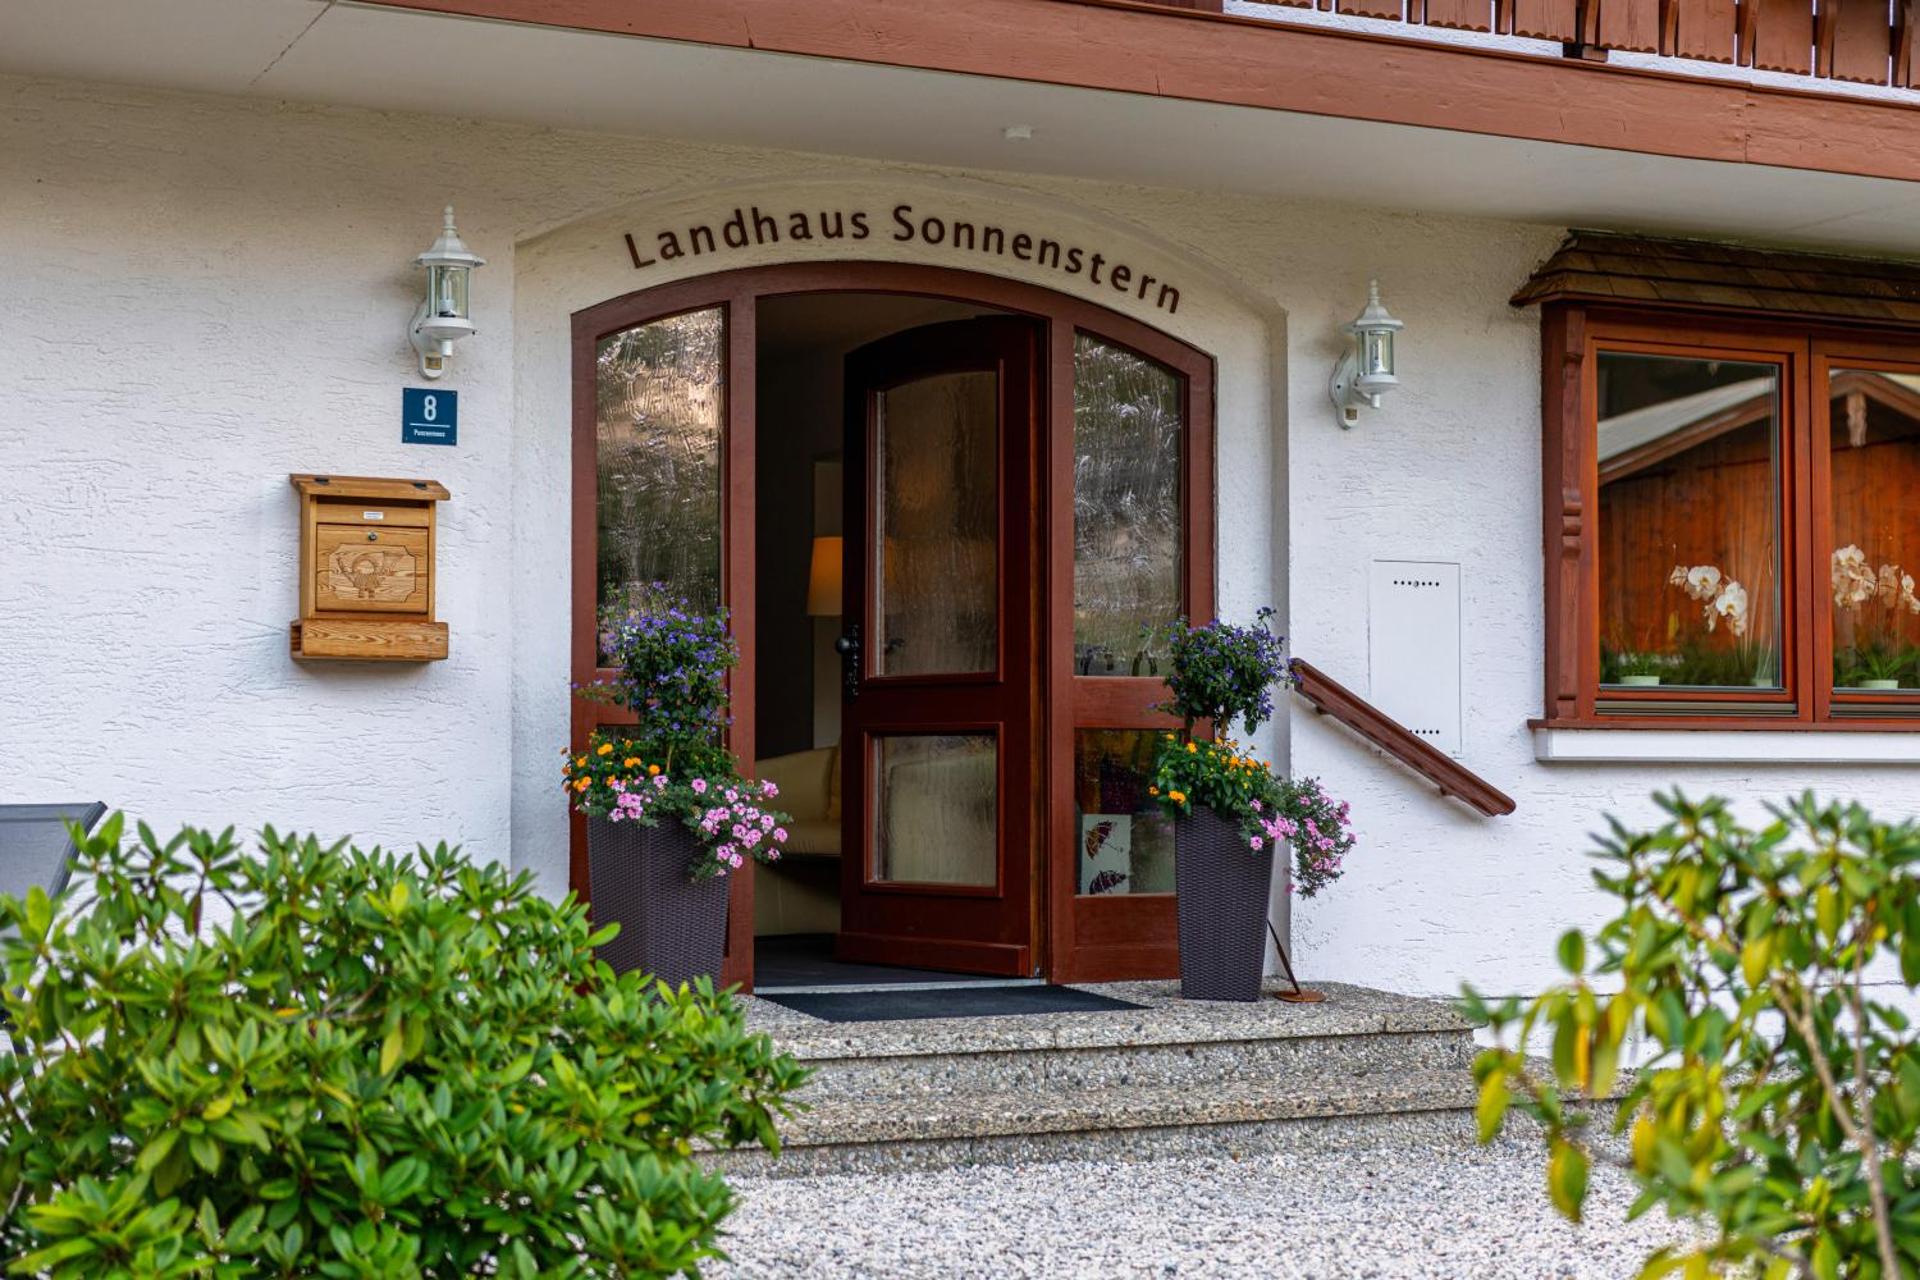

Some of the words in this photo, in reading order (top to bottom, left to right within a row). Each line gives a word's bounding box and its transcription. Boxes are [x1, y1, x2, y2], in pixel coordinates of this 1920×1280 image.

[623, 206, 871, 270] Landhaus
[892, 204, 1180, 314] Sonnenstern
[424, 395, 437, 421] 8
